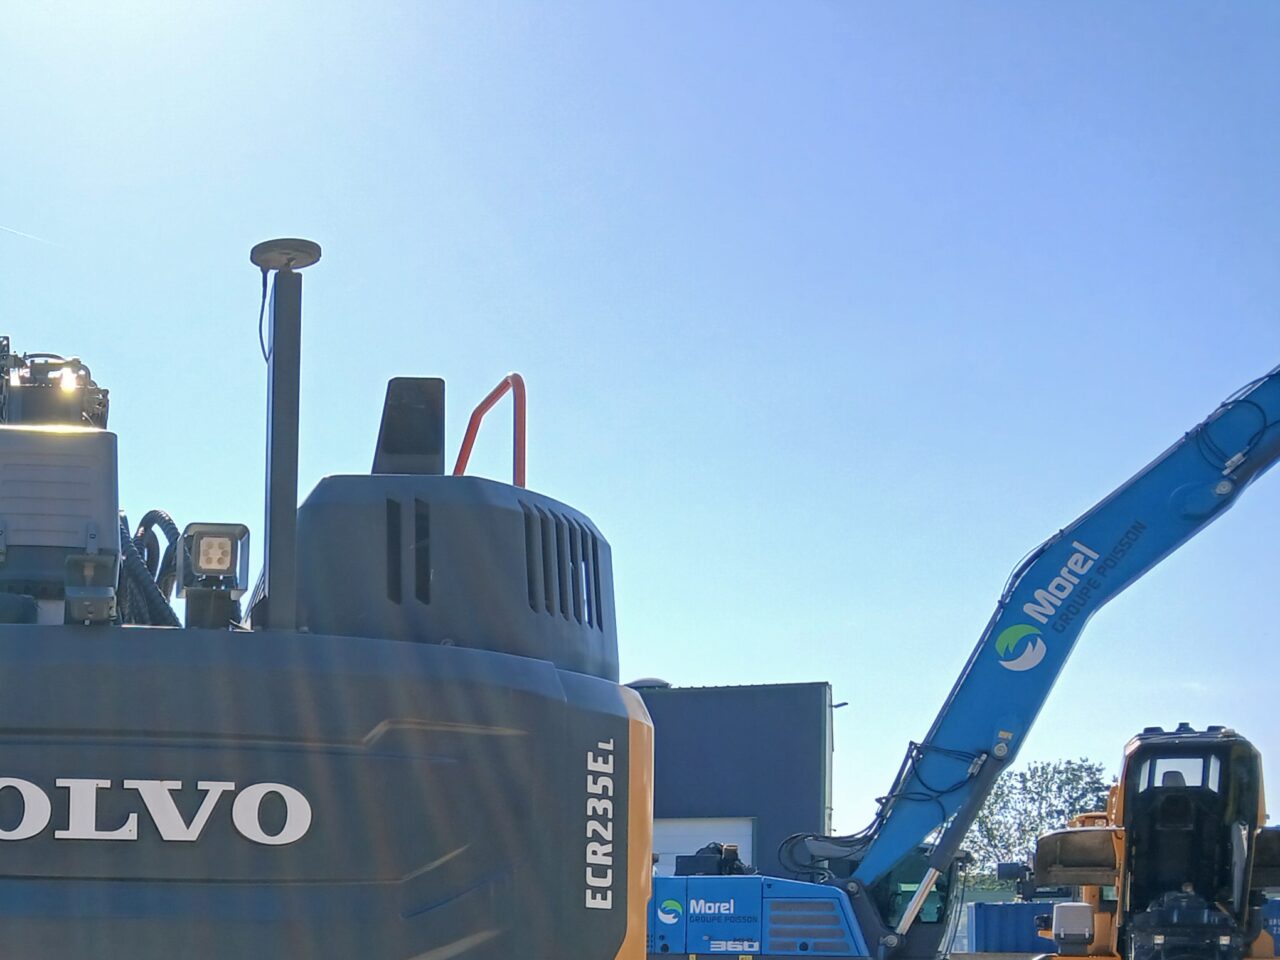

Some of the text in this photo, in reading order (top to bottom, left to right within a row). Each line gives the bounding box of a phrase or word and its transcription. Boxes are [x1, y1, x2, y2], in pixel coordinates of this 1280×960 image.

[1023, 541, 1099, 624] Morel
[1052, 520, 1147, 634] GROUPE POISSON
[586, 739, 614, 909] ECR235EL
[690, 899, 734, 914] Morel
[710, 941, 759, 951] 360
